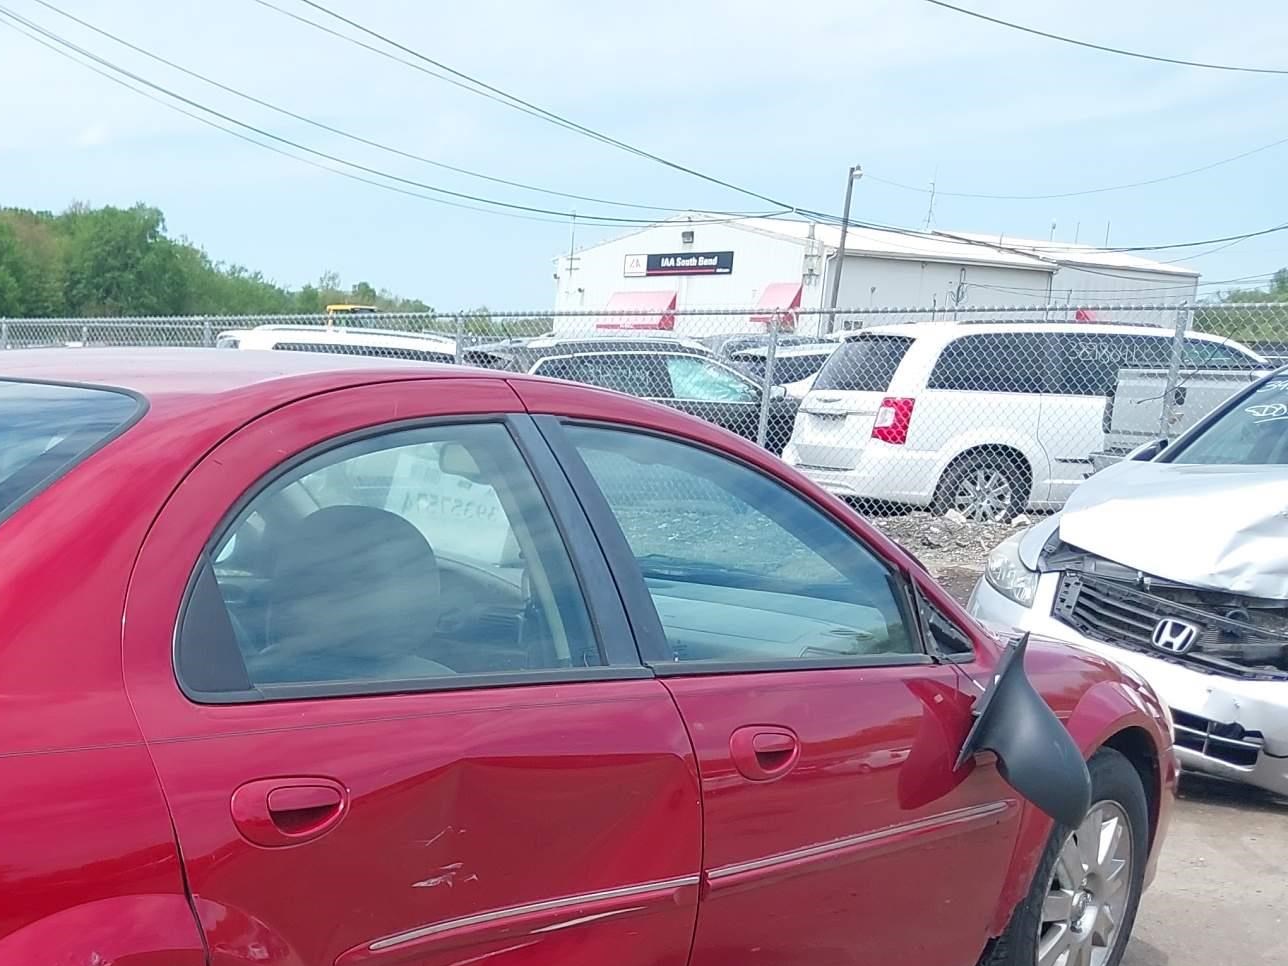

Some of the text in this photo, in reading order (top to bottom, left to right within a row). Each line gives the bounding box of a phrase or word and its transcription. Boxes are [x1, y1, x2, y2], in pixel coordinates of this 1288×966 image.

[660, 256, 717, 267] IAA South Bend
